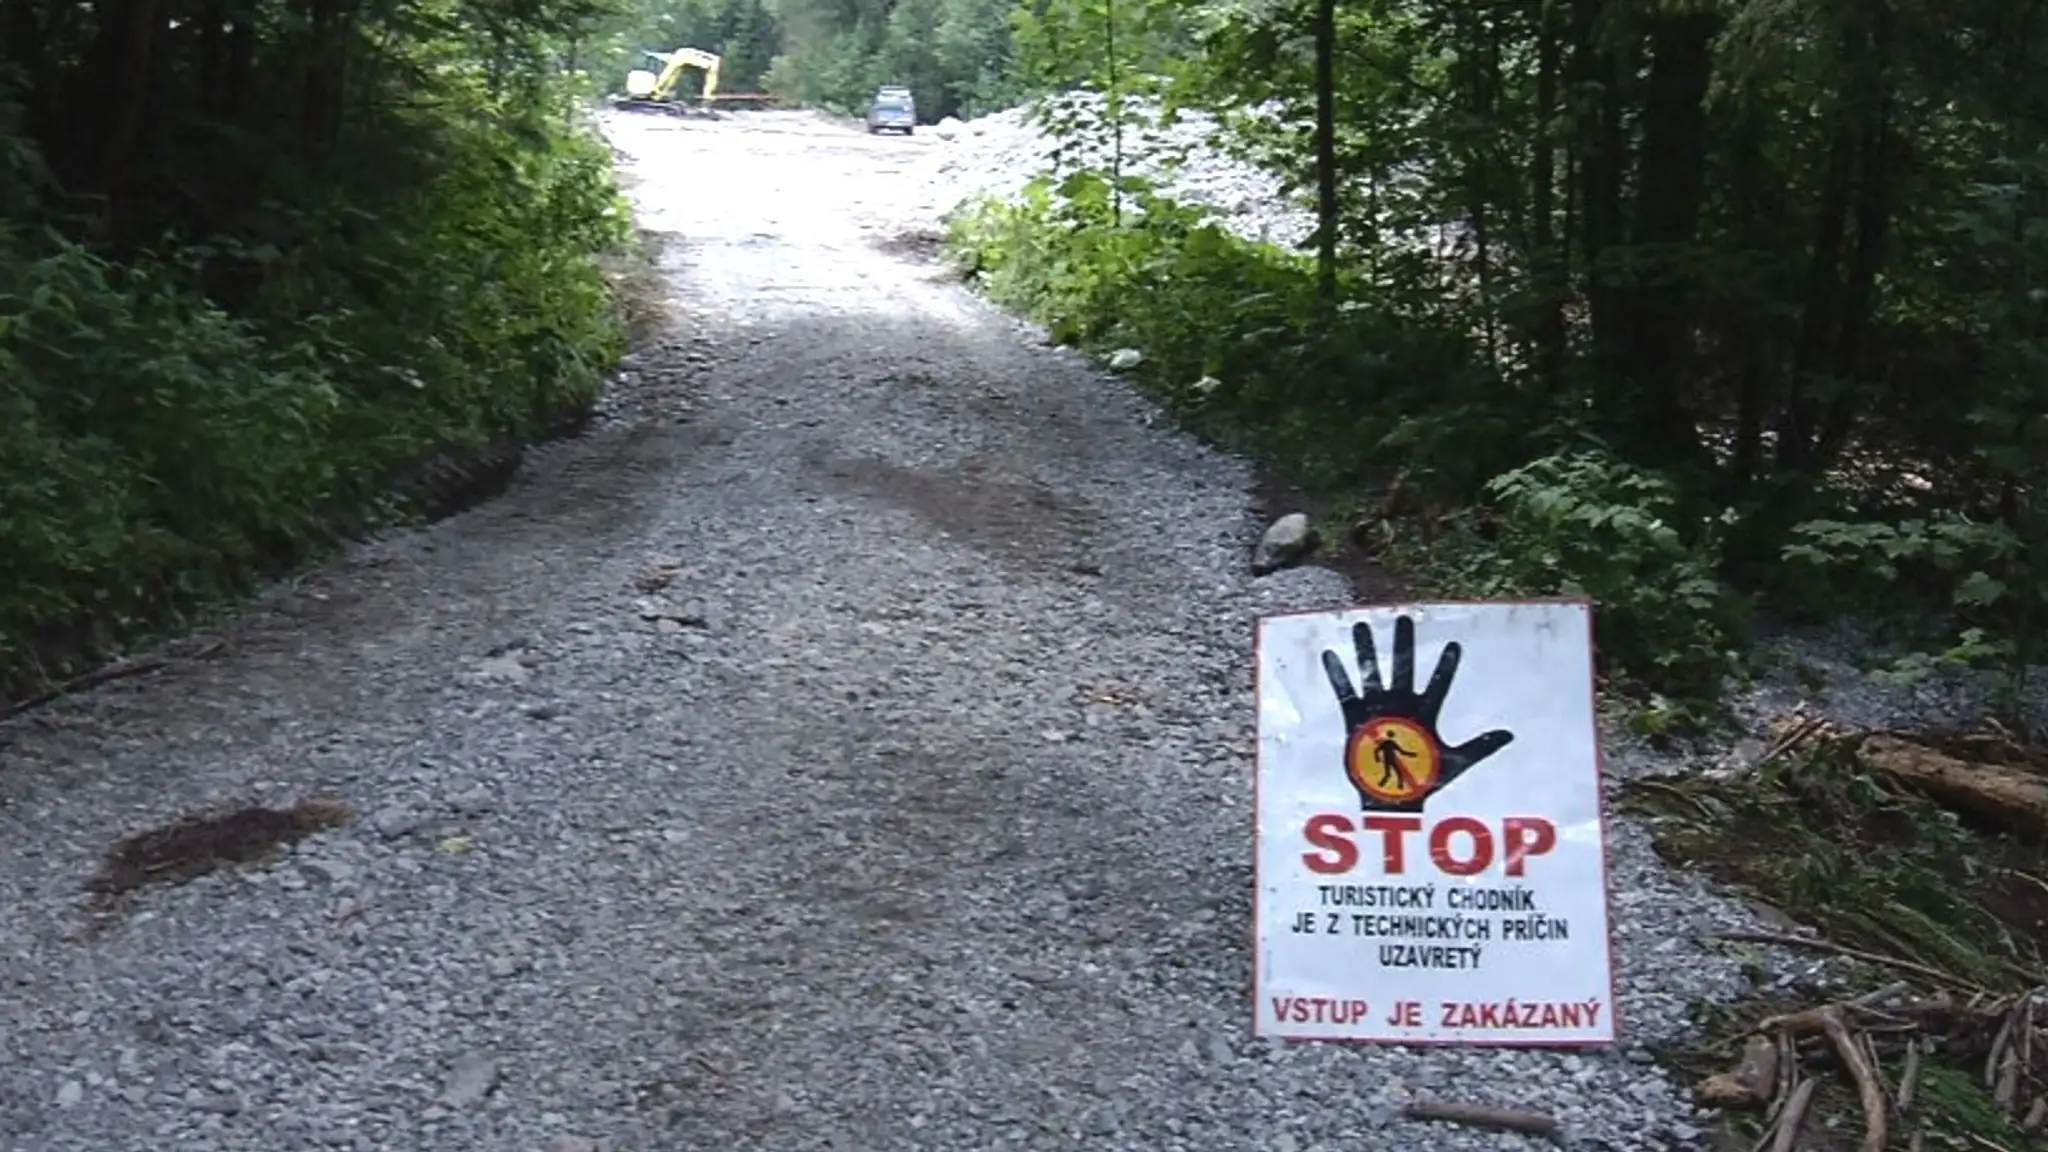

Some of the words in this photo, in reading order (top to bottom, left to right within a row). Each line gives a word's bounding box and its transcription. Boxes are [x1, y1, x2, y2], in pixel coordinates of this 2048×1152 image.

[1301, 813, 1557, 877] STOP
[1318, 884, 1435, 909] TURISTICKÝ
[1448, 886, 1536, 911] CHODNÍK
[1291, 913, 1315, 935] JE
[1327, 914, 1340, 935] Z
[1354, 913, 1490, 940] TECHNICKÝCH
[1503, 914, 1569, 941] PRÍČIN
[1379, 943, 1483, 968] UZAVRETÝ
[1272, 997, 1367, 1024] VSTUP
[1386, 1001, 1422, 1026] JE
[1441, 996, 1601, 1028] ZAKÁZANÝ
